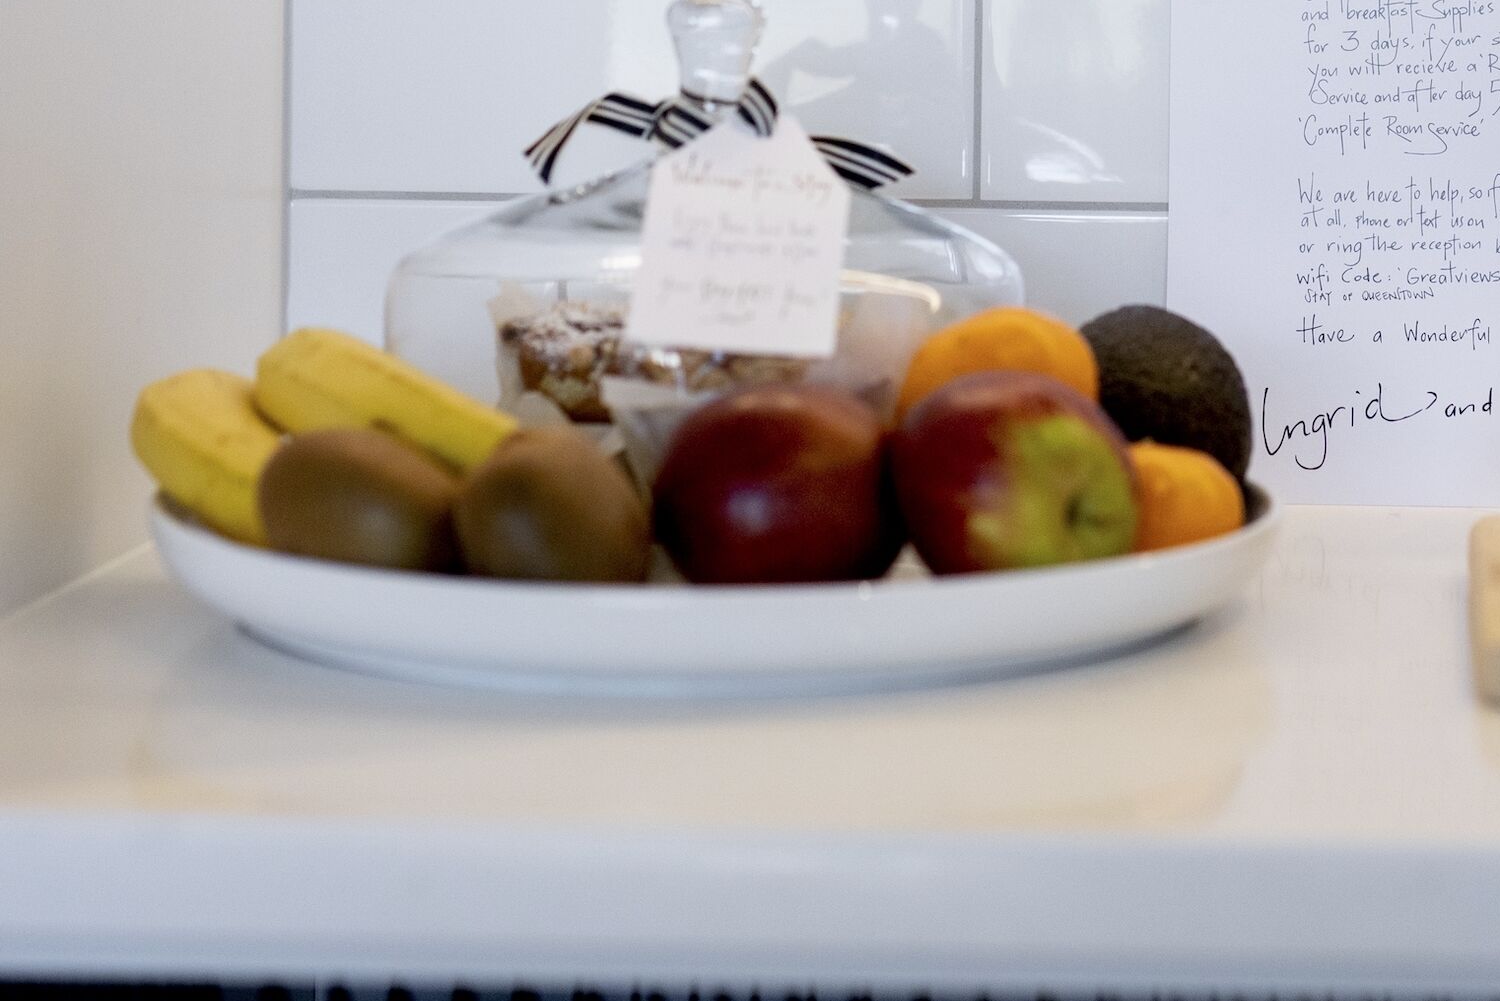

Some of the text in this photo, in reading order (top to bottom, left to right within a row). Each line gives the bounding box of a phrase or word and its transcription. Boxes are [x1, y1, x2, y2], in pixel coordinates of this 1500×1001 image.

[1301, 0, 1329, 22] and
[1303, 22, 1329, 54] for
[1340, 30, 1360, 52] 3
[1421, 23, 1436, 61] if
[1438, 35, 1481, 66] your
[1307, 63, 1338, 96] you
[1349, 52, 1381, 76] will
[1396, 60, 1458, 75] recieve
[1466, 62, 1478, 72] a
[1310, 78, 1369, 105] Service
[1374, 86, 1400, 104] and
[1400, 78, 1448, 113] after
[1455, 80, 1482, 118] day
[1382, 115, 1424, 143] Room
[1297, 171, 1324, 203] We
[1333, 189, 1357, 204] are
[1366, 179, 1402, 203] here
[1429, 176, 1464, 216] help,
[1468, 187, 1483, 200] so
[1300, 205, 1325, 228] at
[1355, 210, 1391, 230] phone
[1415, 204, 1442, 237] text
[1450, 216, 1464, 229] us
[1466, 218, 1485, 229] on
[1299, 243, 1315, 254] or
[1326, 236, 1362, 267] ring
[1363, 232, 1403, 251] the
[1411, 233, 1482, 261] reception
[1296, 263, 1330, 291] wifi
[1295, 313, 1355, 346] Have
[1372, 330, 1383, 344] a
[1262, 382, 1438, 470] Ingrid
[1444, 386, 1493, 417] and
